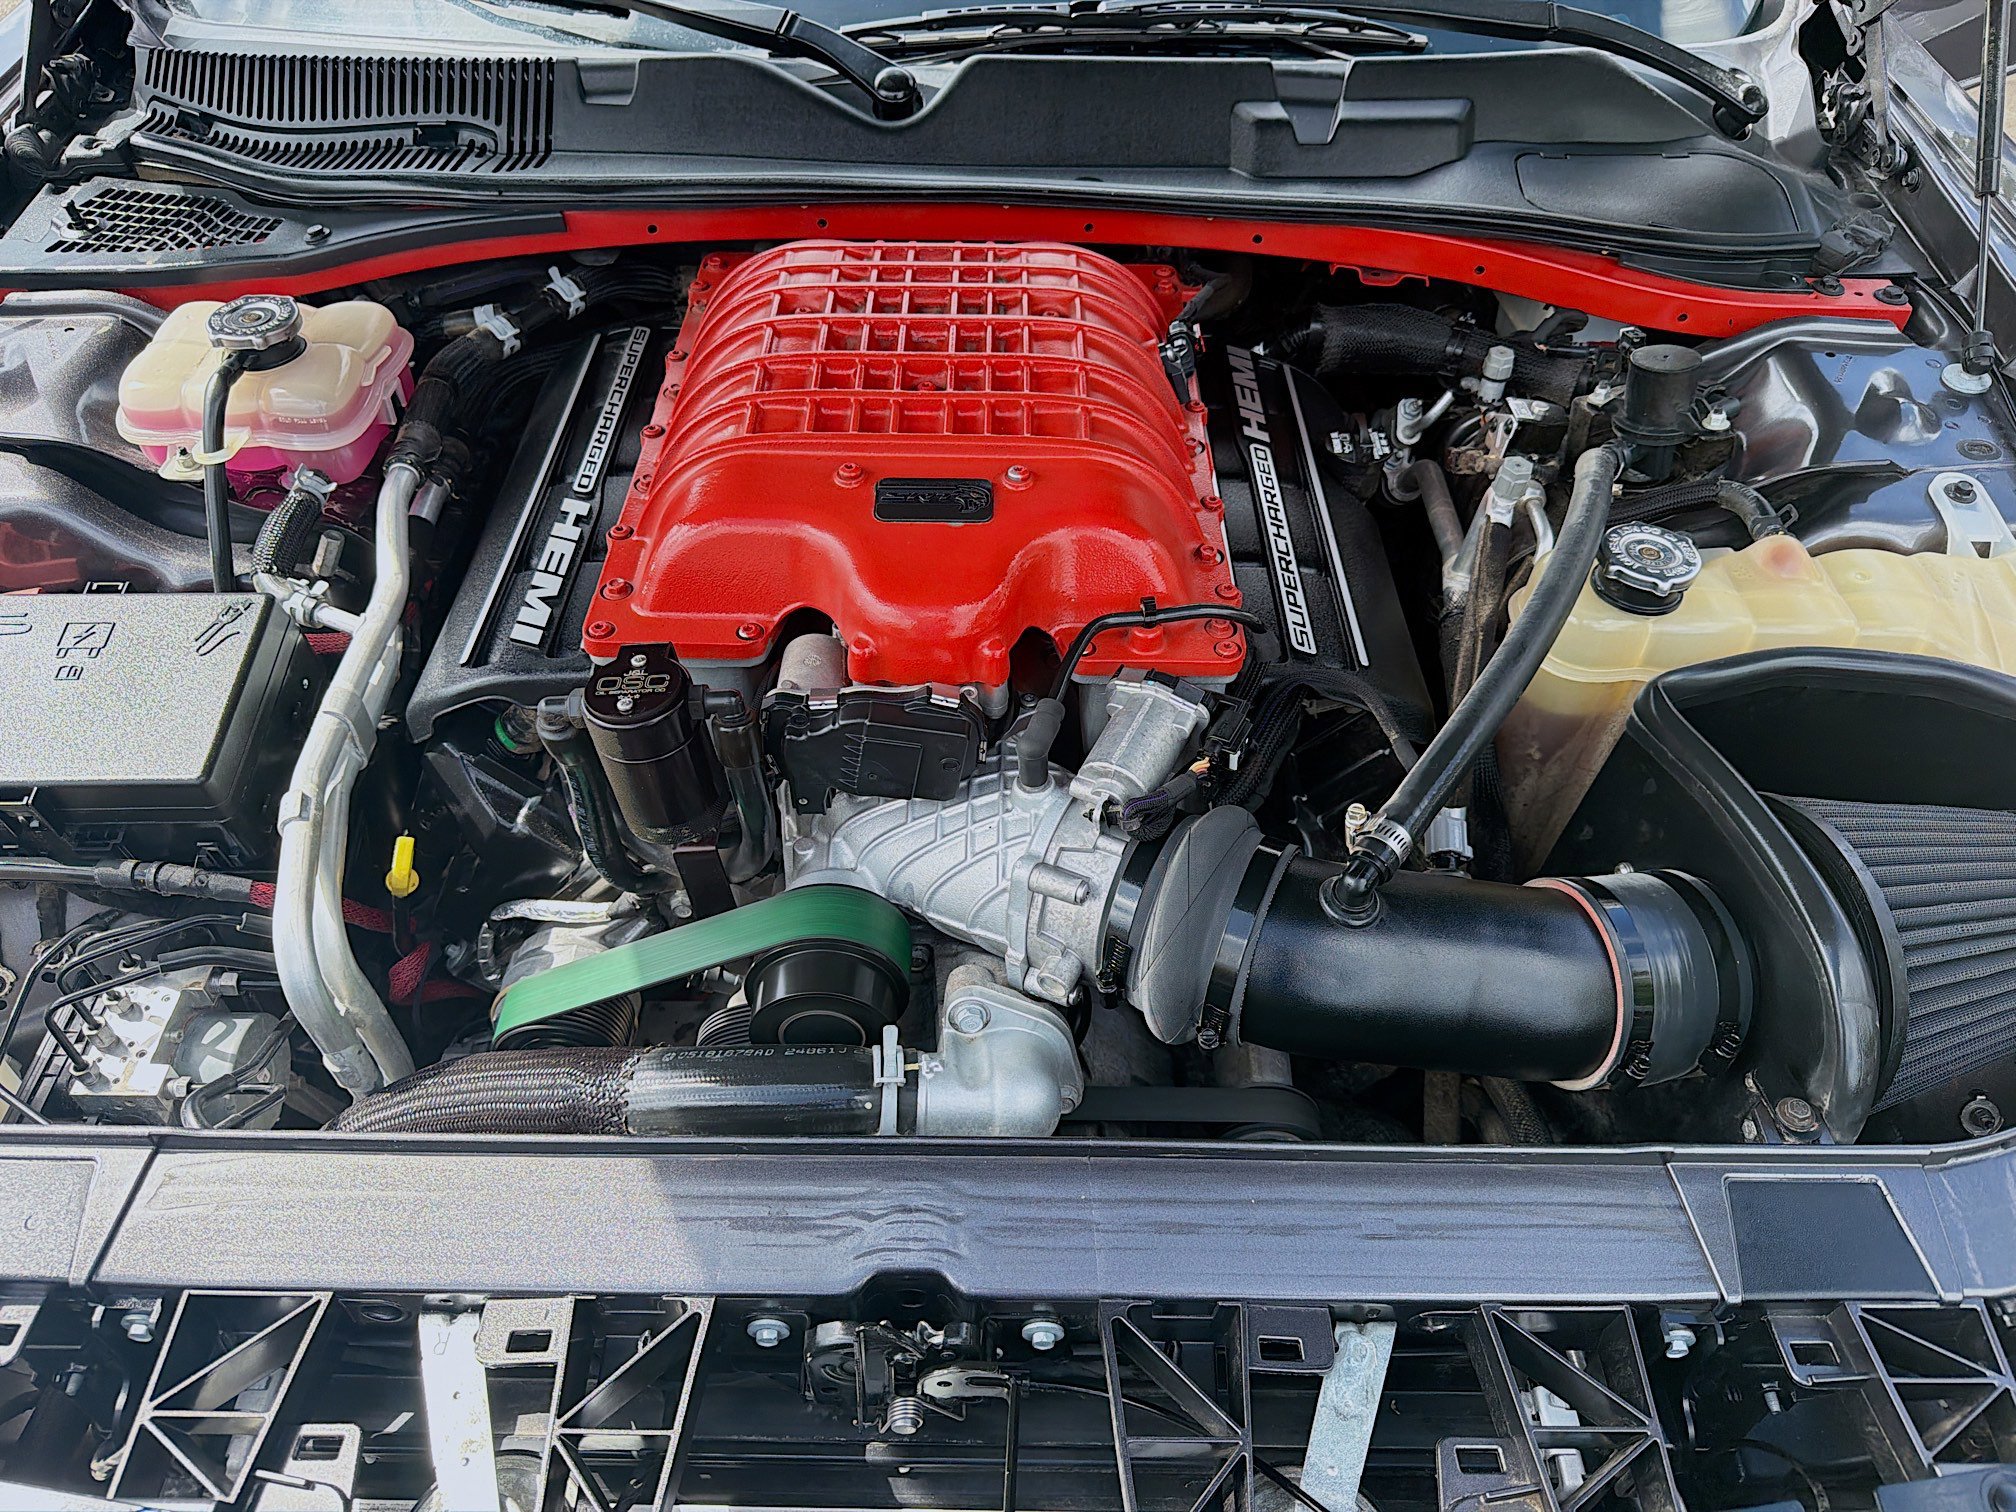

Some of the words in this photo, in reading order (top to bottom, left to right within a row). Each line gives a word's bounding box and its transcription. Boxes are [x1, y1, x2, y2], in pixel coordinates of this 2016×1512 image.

[577, 327, 647, 491] SUPERCHARGED
[1226, 345, 1270, 441] HEMI
[510, 497, 591, 645] HEMI
[1252, 445, 1314, 652] SUPERCHARGED
[597, 674, 670, 691] OSC
